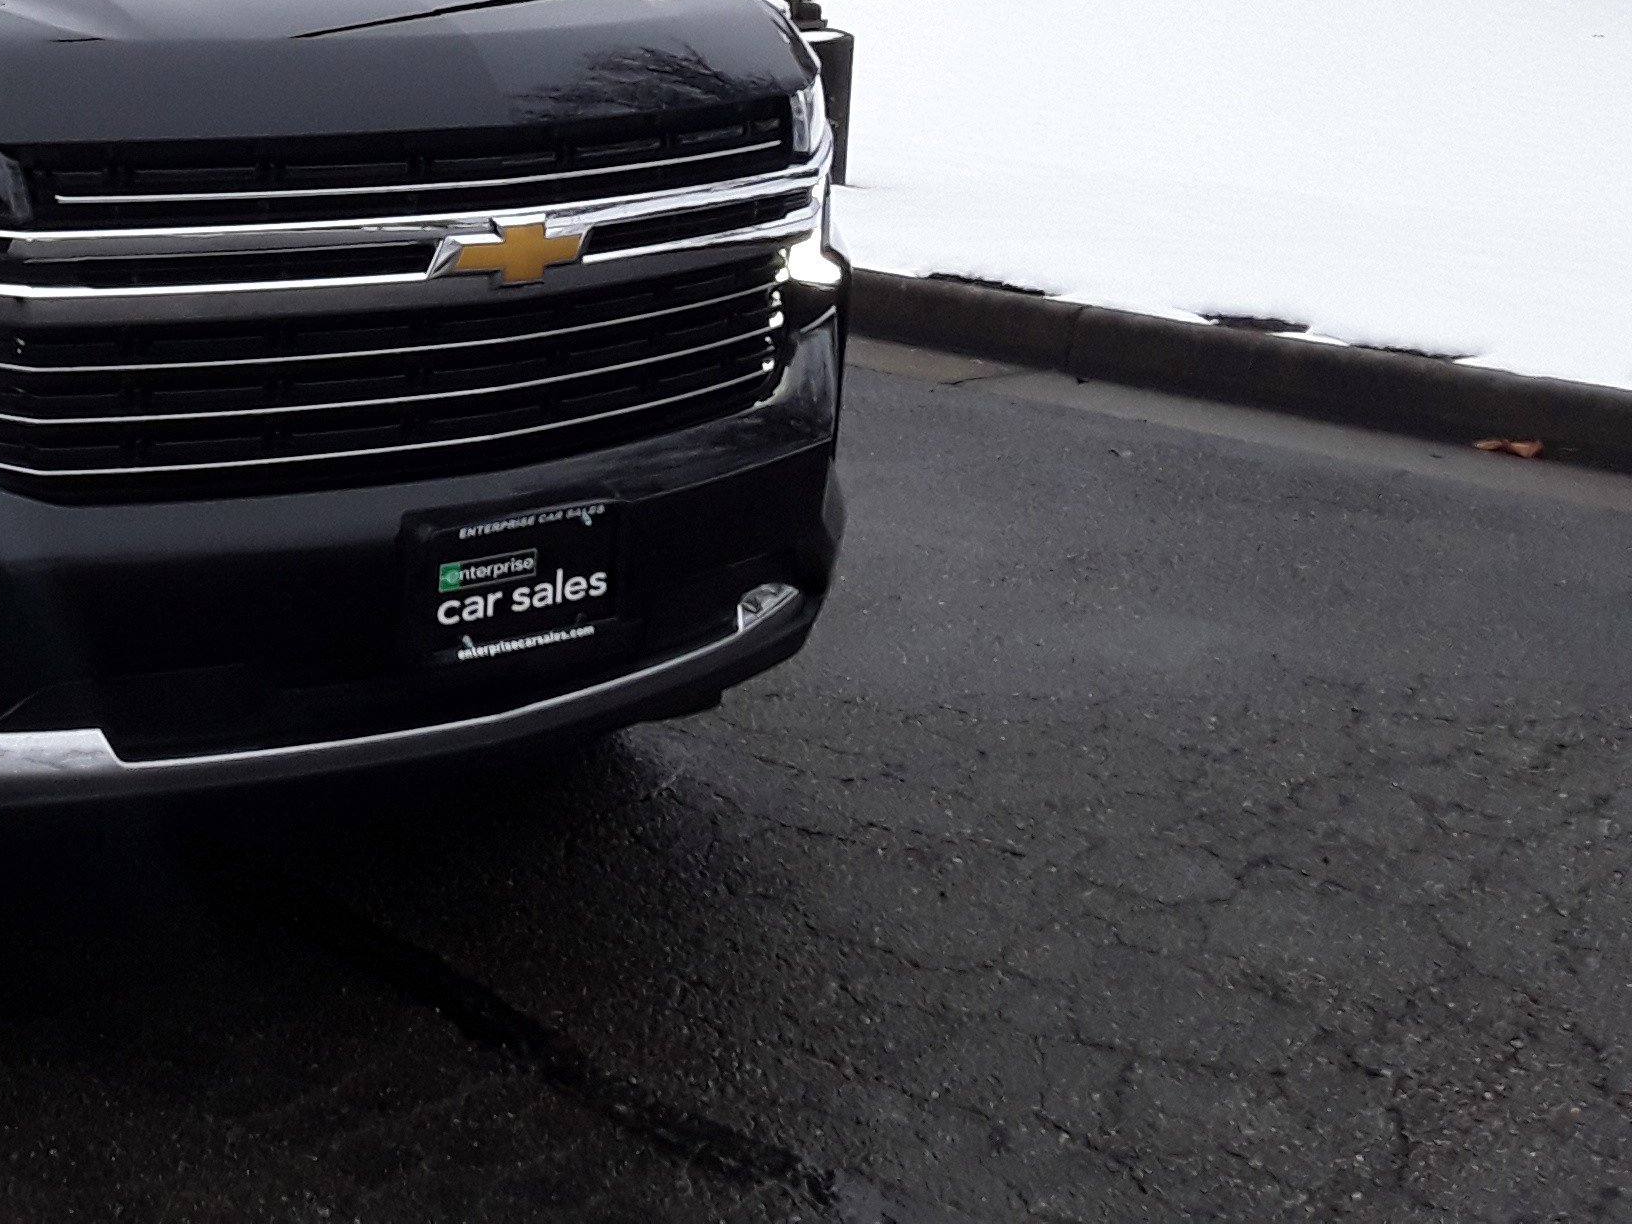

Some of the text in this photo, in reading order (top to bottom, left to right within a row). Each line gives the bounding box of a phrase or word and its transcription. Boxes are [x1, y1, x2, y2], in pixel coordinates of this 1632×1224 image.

[459, 515, 536, 539] ENTERPRISE
[538, 510, 564, 524] CAR
[441, 557, 535, 584] enterprise
[437, 568, 608, 626] car sales
[458, 625, 595, 660] enterprisecarsales.com
